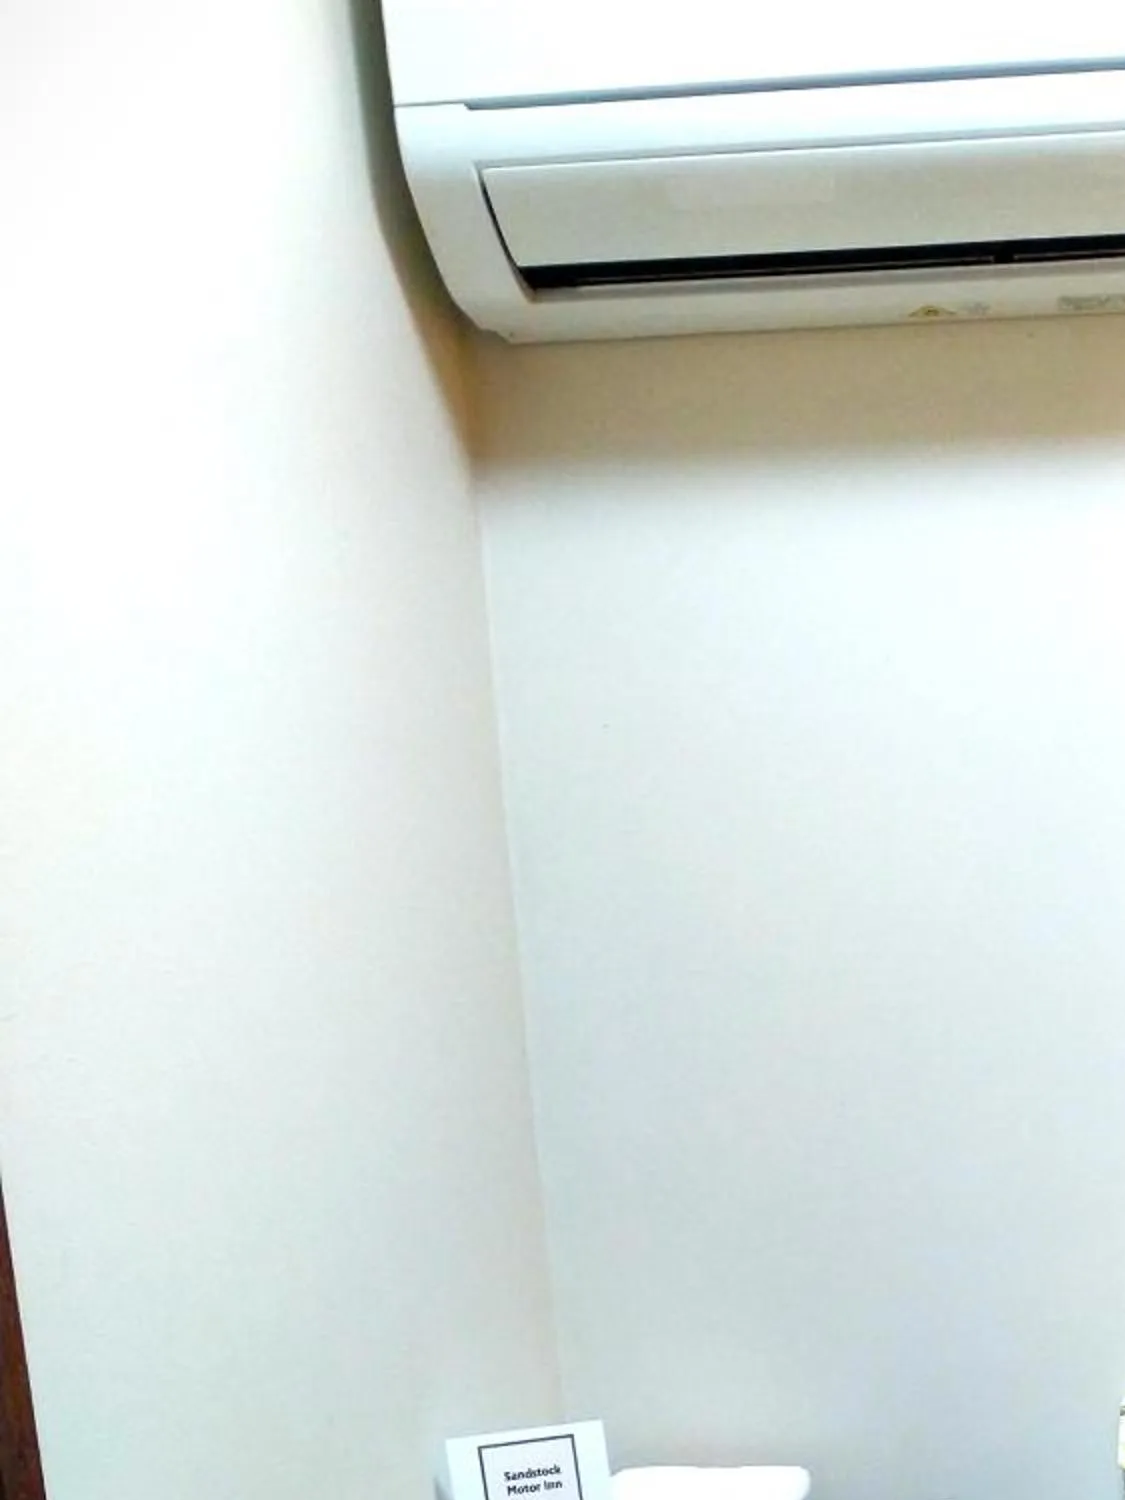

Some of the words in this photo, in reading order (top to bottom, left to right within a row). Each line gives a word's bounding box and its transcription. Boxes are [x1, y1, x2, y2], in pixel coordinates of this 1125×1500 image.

[503, 1464, 562, 1481] Sandstock
[507, 1483, 541, 1496] Motor
[543, 1480, 563, 1491] Inn
